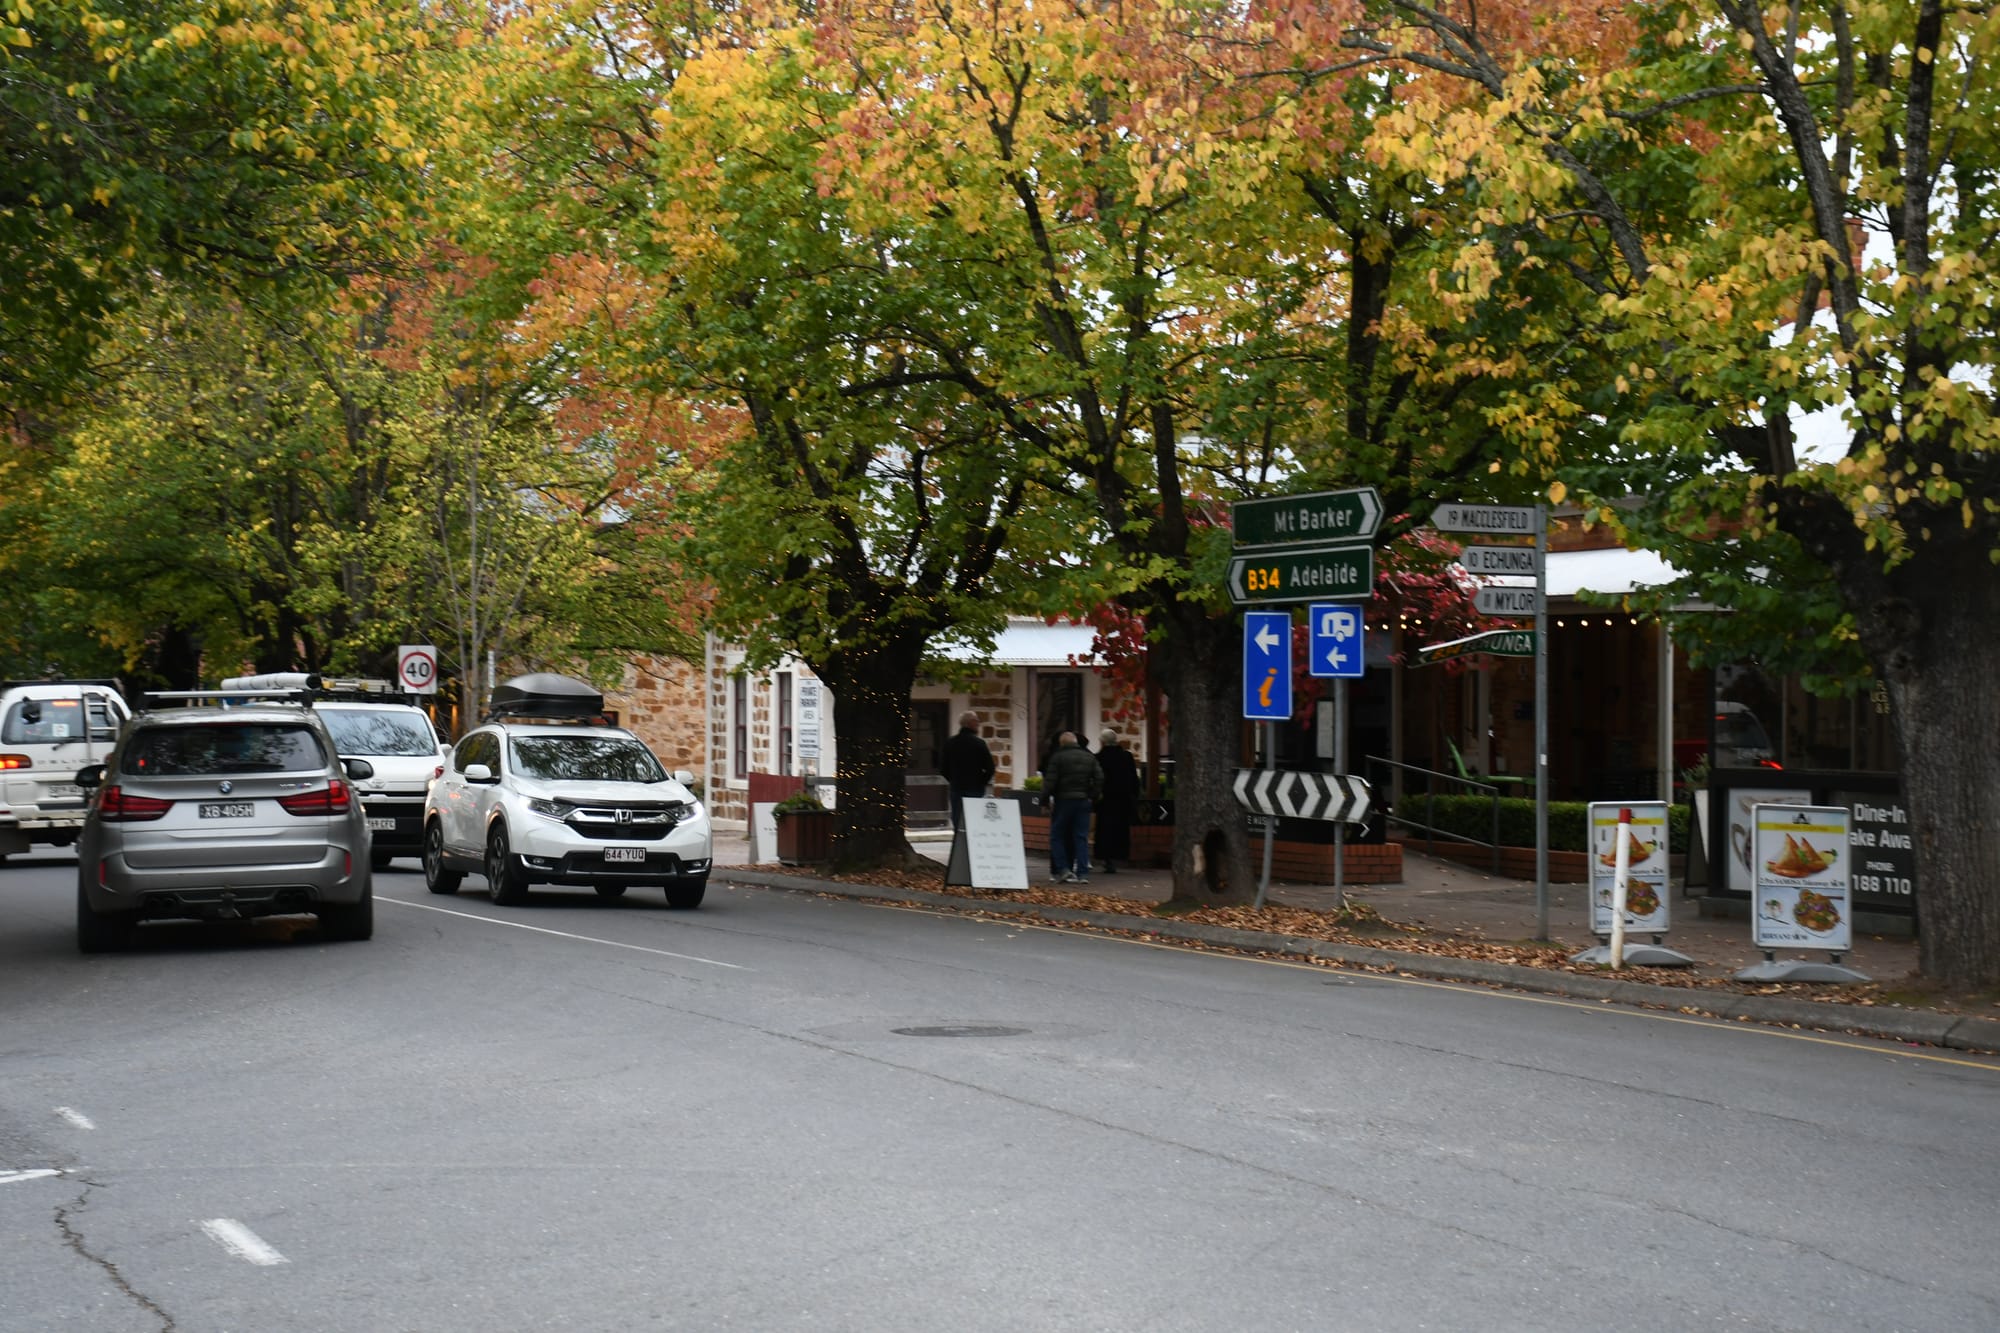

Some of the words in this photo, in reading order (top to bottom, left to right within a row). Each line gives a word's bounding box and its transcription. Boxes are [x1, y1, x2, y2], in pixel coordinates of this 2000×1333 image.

[1274, 510, 1295, 532] Mt
[1300, 507, 1352, 530] Barker
[1448, 510, 1459, 525] 19
[1461, 510, 1528, 529] MACCLESFIELD
[1468, 551, 1478, 567] 10
[1484, 551, 1535, 570] ECHUNGA
[1248, 568, 1281, 590] B34
[1290, 563, 1358, 587] Adelaide
[1495, 593, 1535, 611] MYLOR
[406, 662, 431, 678] 40
[1850, 828, 1876, 847] ake
[1879, 830, 1912, 849] Awa
[1852, 875, 1880, 892] 188
[1884, 877, 1911, 894] 110
